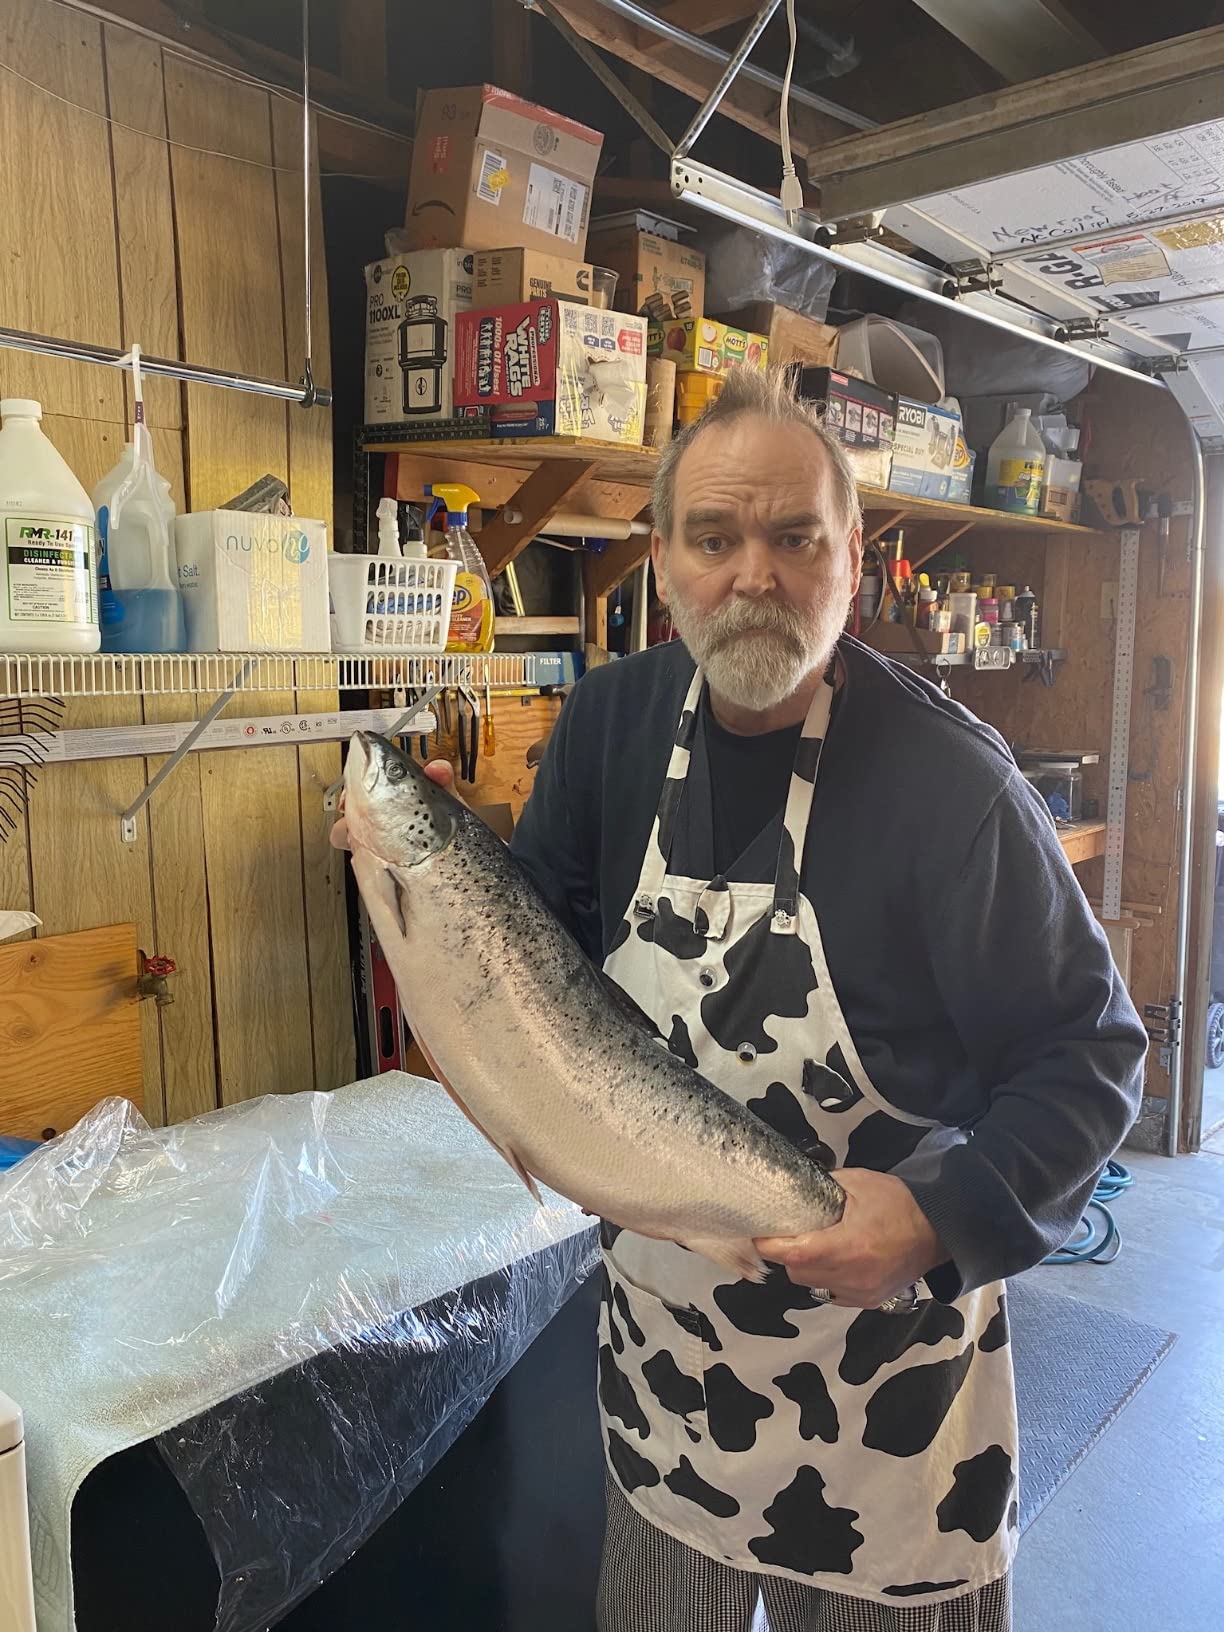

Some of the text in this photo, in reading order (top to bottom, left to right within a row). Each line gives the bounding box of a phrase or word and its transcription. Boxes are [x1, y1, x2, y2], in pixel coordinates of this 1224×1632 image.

[992, 224, 1048, 243] New
[457, 284, 472, 295] PRO
[529, 277, 552, 289] GENUINE
[530, 287, 547, 298] PARTS
[370, 293, 384, 308] PRO
[369, 304, 400, 324] 1100XL
[494, 316, 502, 351] 1000s
[726, 336, 746, 349] MOTT'S
[517, 315, 531, 388] WHITE
[530, 329, 539, 384] PROFESSIONAL
[504, 332, 522, 397] RAGS
[899, 405, 925, 425] RYOBI
[20, 526, 72, 541] RMR-141
[23, 549, 74, 561] DISINFECTA
[539, 657, 562, 665] FILTER
